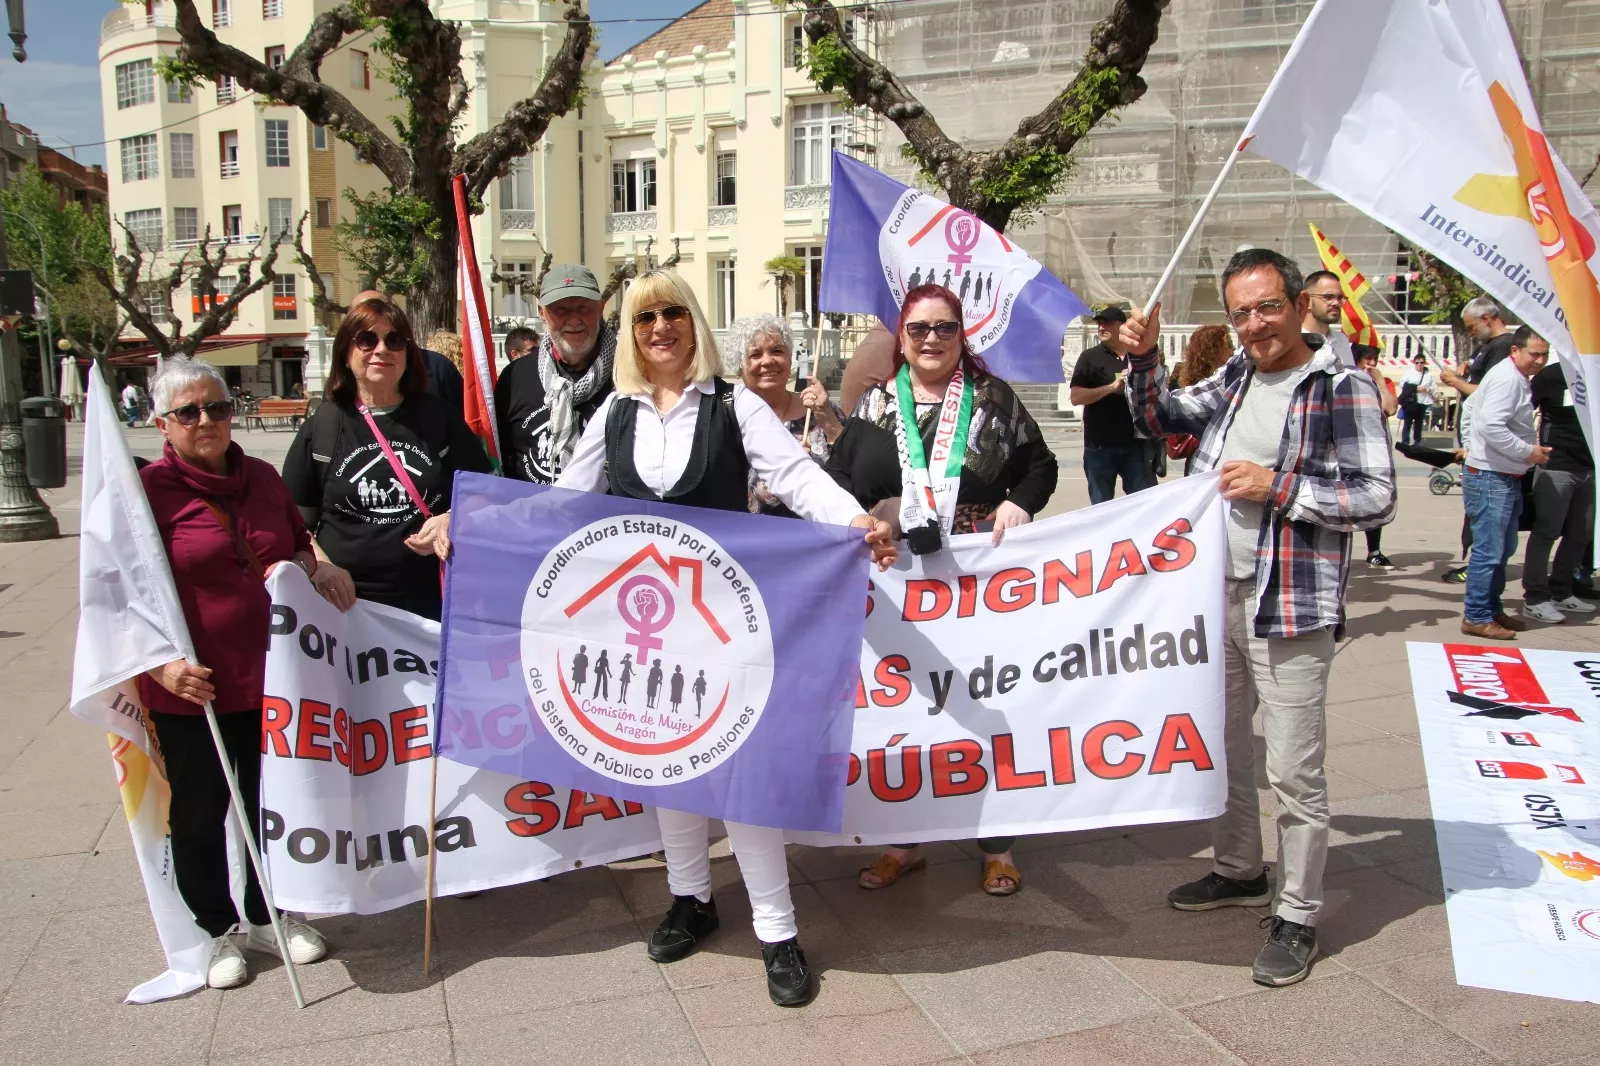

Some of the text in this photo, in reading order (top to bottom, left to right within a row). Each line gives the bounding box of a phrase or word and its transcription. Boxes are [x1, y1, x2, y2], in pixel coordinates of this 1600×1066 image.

[889, 191, 923, 234] Coordina
[885, 266, 895, 283] del
[1419, 203, 1554, 309] Intersindical
[964, 309, 985, 322] Mujer
[980, 292, 1014, 346] Pensiones
[391, 440, 403, 448] por
[405, 442, 411, 450] la
[411, 445, 433, 467] Defensa
[372, 517, 401, 525] Público
[267, 604, 337, 667] Por
[901, 517, 1197, 622] DIGNAS
[536, 519, 759, 634] Coordinadora Estatal por la Defensa
[927, 668, 954, 716] y
[968, 655, 1022, 701] de
[1032, 614, 1209, 684] calidad
[529, 667, 756, 780] del Sistema Público de Pensiones
[581, 699, 694, 735] Comisión de Mujer
[615, 722, 657, 740] Aragón
[1481, 761, 1506, 778] CGT
